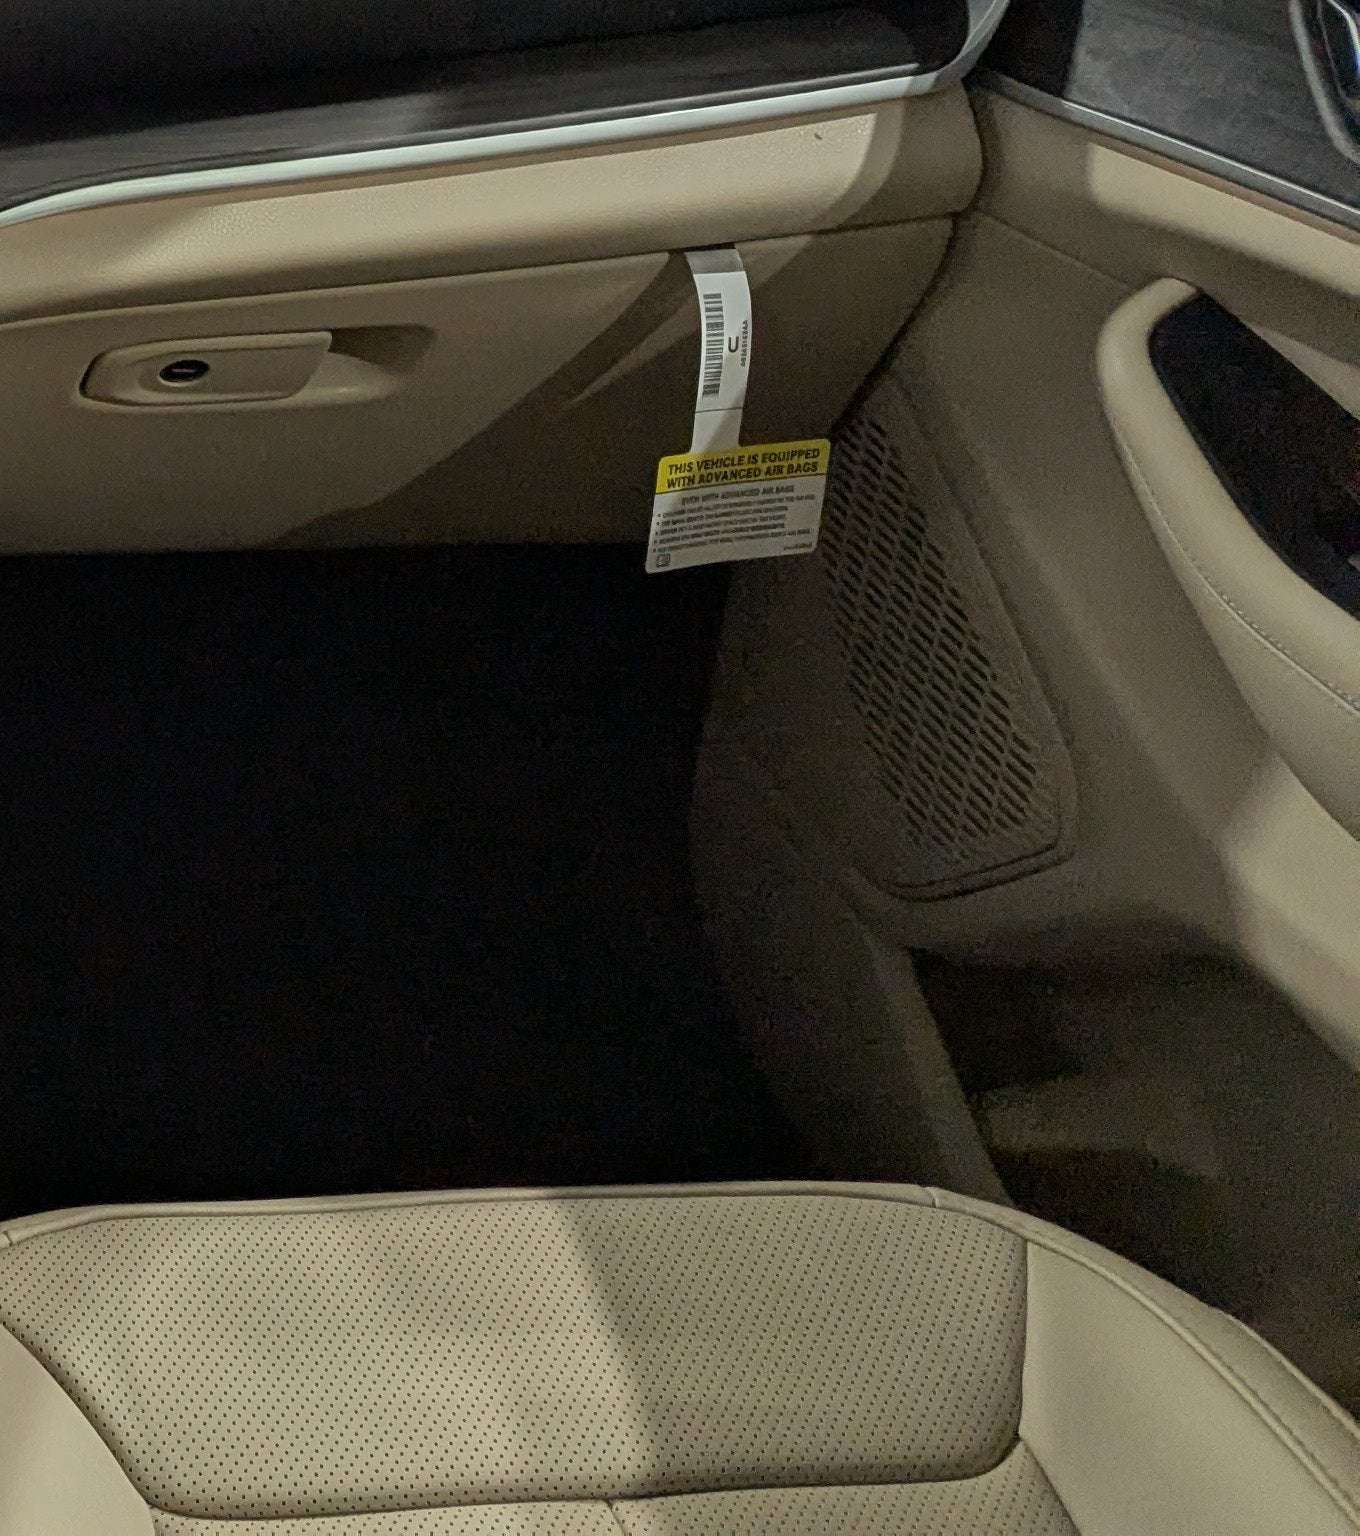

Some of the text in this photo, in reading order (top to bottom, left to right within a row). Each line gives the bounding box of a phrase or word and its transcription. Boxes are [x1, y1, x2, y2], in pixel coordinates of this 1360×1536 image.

[667, 461, 818, 488] WITH ADVANCED AIR BAGS
[668, 448, 820, 475] THIS VEHICLE IS EQUIPPED
